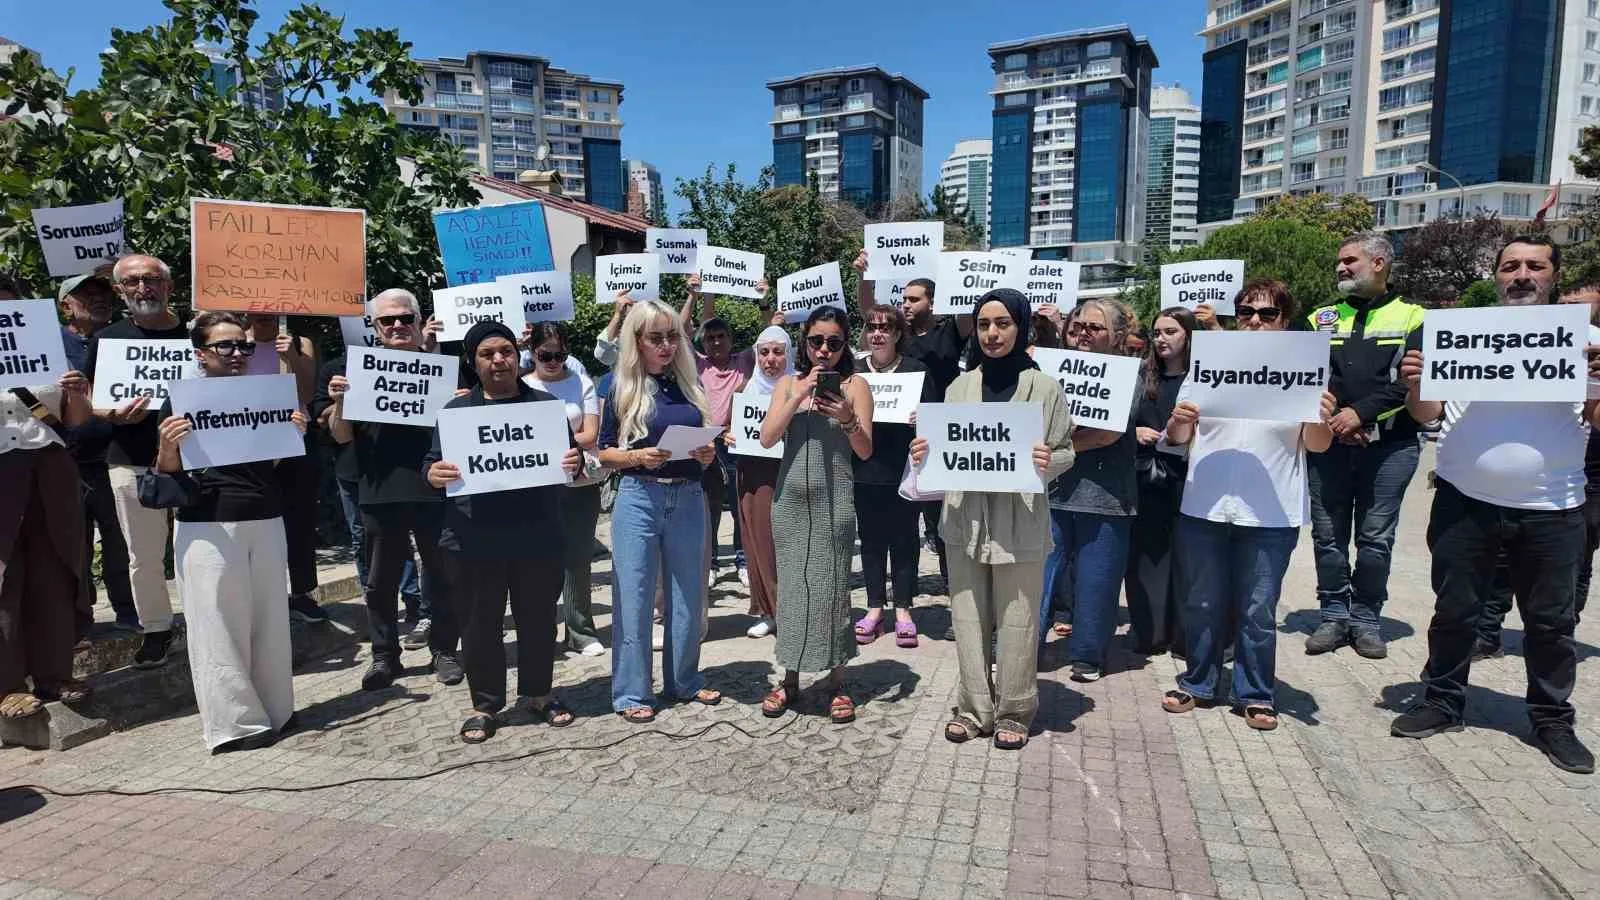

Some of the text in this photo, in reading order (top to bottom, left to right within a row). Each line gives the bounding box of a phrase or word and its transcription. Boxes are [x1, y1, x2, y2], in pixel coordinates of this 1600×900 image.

[448, 208, 533, 233] ADALET
[464, 229, 533, 250] HEMEN
[656, 238, 698, 249] Susmak
[877, 234, 930, 249] Susmak
[73, 245, 103, 260] Dur
[225, 243, 340, 263] KORUYAN
[667, 253, 688, 264] Yok
[890, 254, 915, 266] Yok
[610, 263, 642, 277] İçimiz
[714, 255, 747, 271] Ölmek
[959, 258, 1006, 274] Sesim
[1030, 264, 1063, 277] dalet
[791, 276, 823, 293] Kabul
[963, 275, 998, 289] Olur
[1027, 281, 1063, 290] emen
[1171, 270, 1233, 285] Güvende
[521, 283, 552, 296] Artık
[605, 281, 647, 293] Yanıyor
[455, 296, 503, 308] Dayan
[781, 292, 839, 311] Etmiyoruz
[1178, 288, 1226, 303] Değiliz
[1436, 326, 1574, 354] Barışacak
[126, 346, 193, 361] Dikkat
[134, 365, 182, 380] Katil
[363, 354, 443, 376] Buradan
[1059, 358, 1107, 378] Alkol
[1431, 358, 1576, 380] Kimse Yok
[1193, 360, 1324, 390] İsyandayız!
[110, 383, 169, 402] Çıkab
[374, 376, 429, 395] Azrail
[375, 396, 424, 417] Geçti
[184, 408, 294, 431] Affetmiyoruz
[478, 422, 534, 444] Evlat
[947, 422, 1010, 442] Bıktık
[468, 452, 549, 474] Kokusu
[943, 451, 1016, 472] Vallahi
